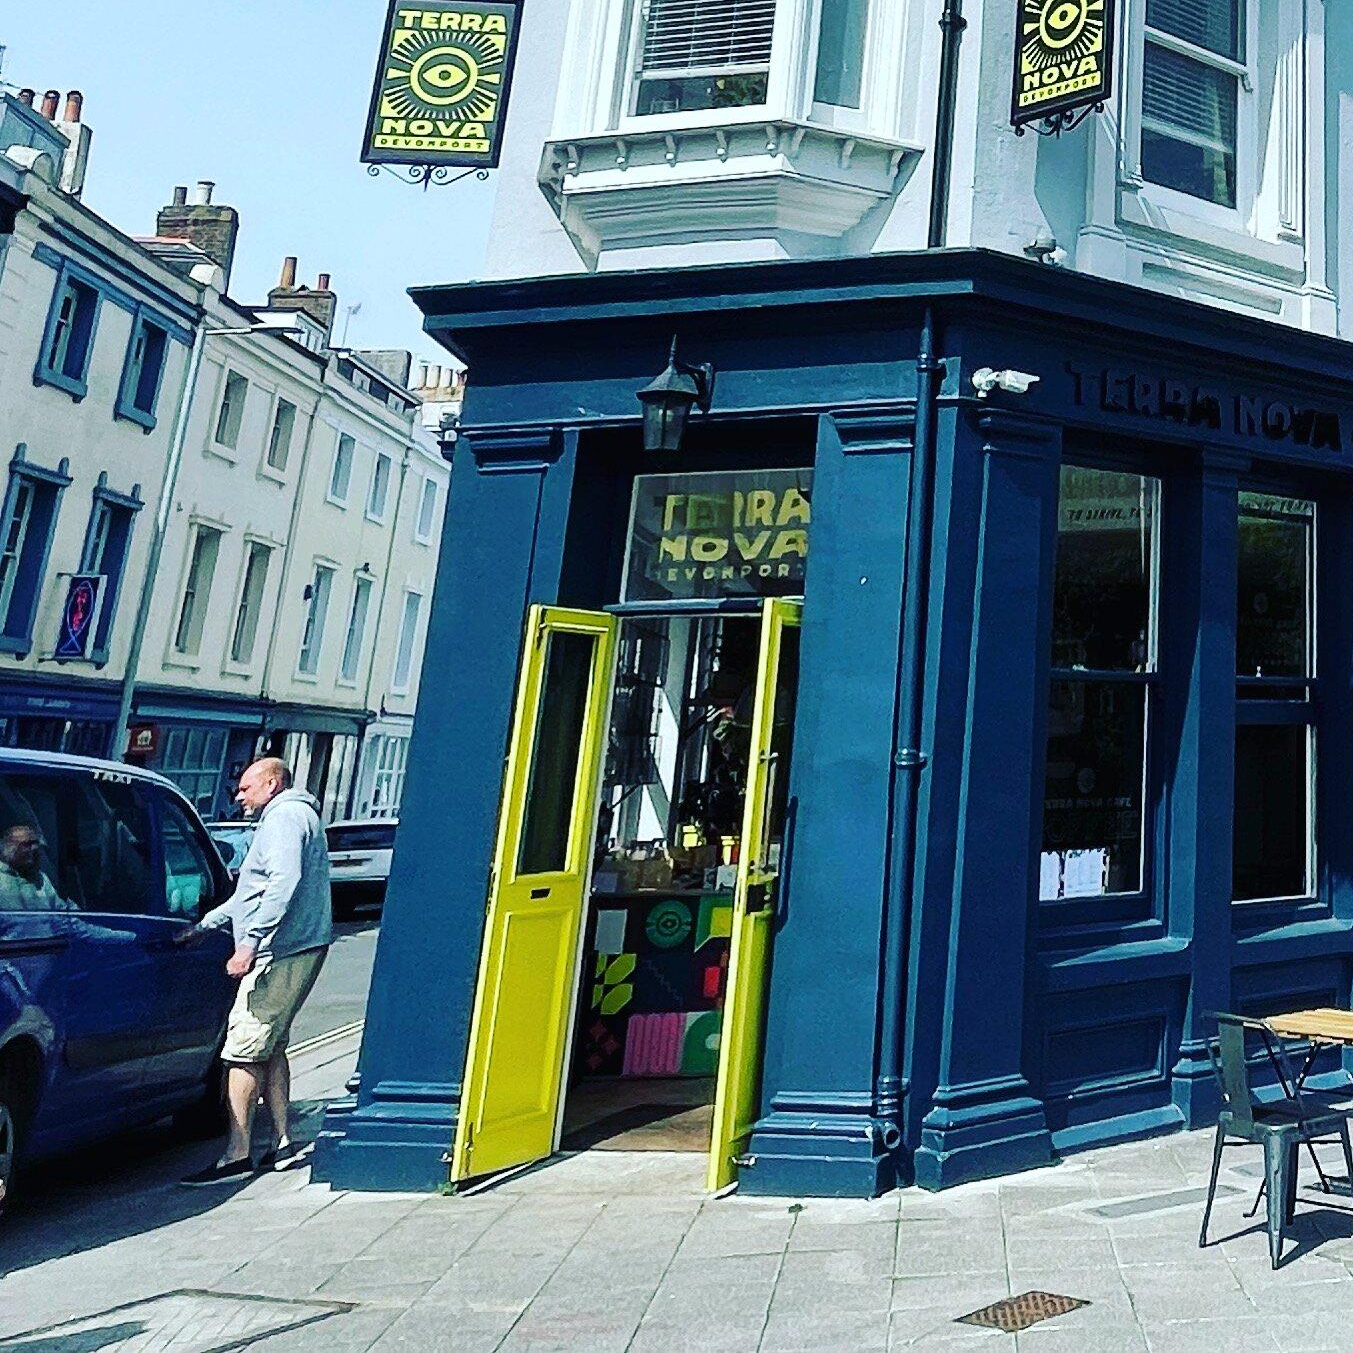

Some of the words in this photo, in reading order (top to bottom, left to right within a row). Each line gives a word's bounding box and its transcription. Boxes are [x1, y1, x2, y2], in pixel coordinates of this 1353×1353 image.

[398, 10, 507, 33] TERRA
[1023, 55, 1098, 91] NOVA
[1023, 74, 1097, 103] DEVONPORT
[381, 118, 486, 138] NOVA
[380, 138, 484, 150] DEVONPORT
[1066, 362, 1222, 428] TERRA
[1234, 395, 1341, 451] NOVA
[658, 530, 809, 563] NOVA
[92, 769, 131, 784] TAXI
